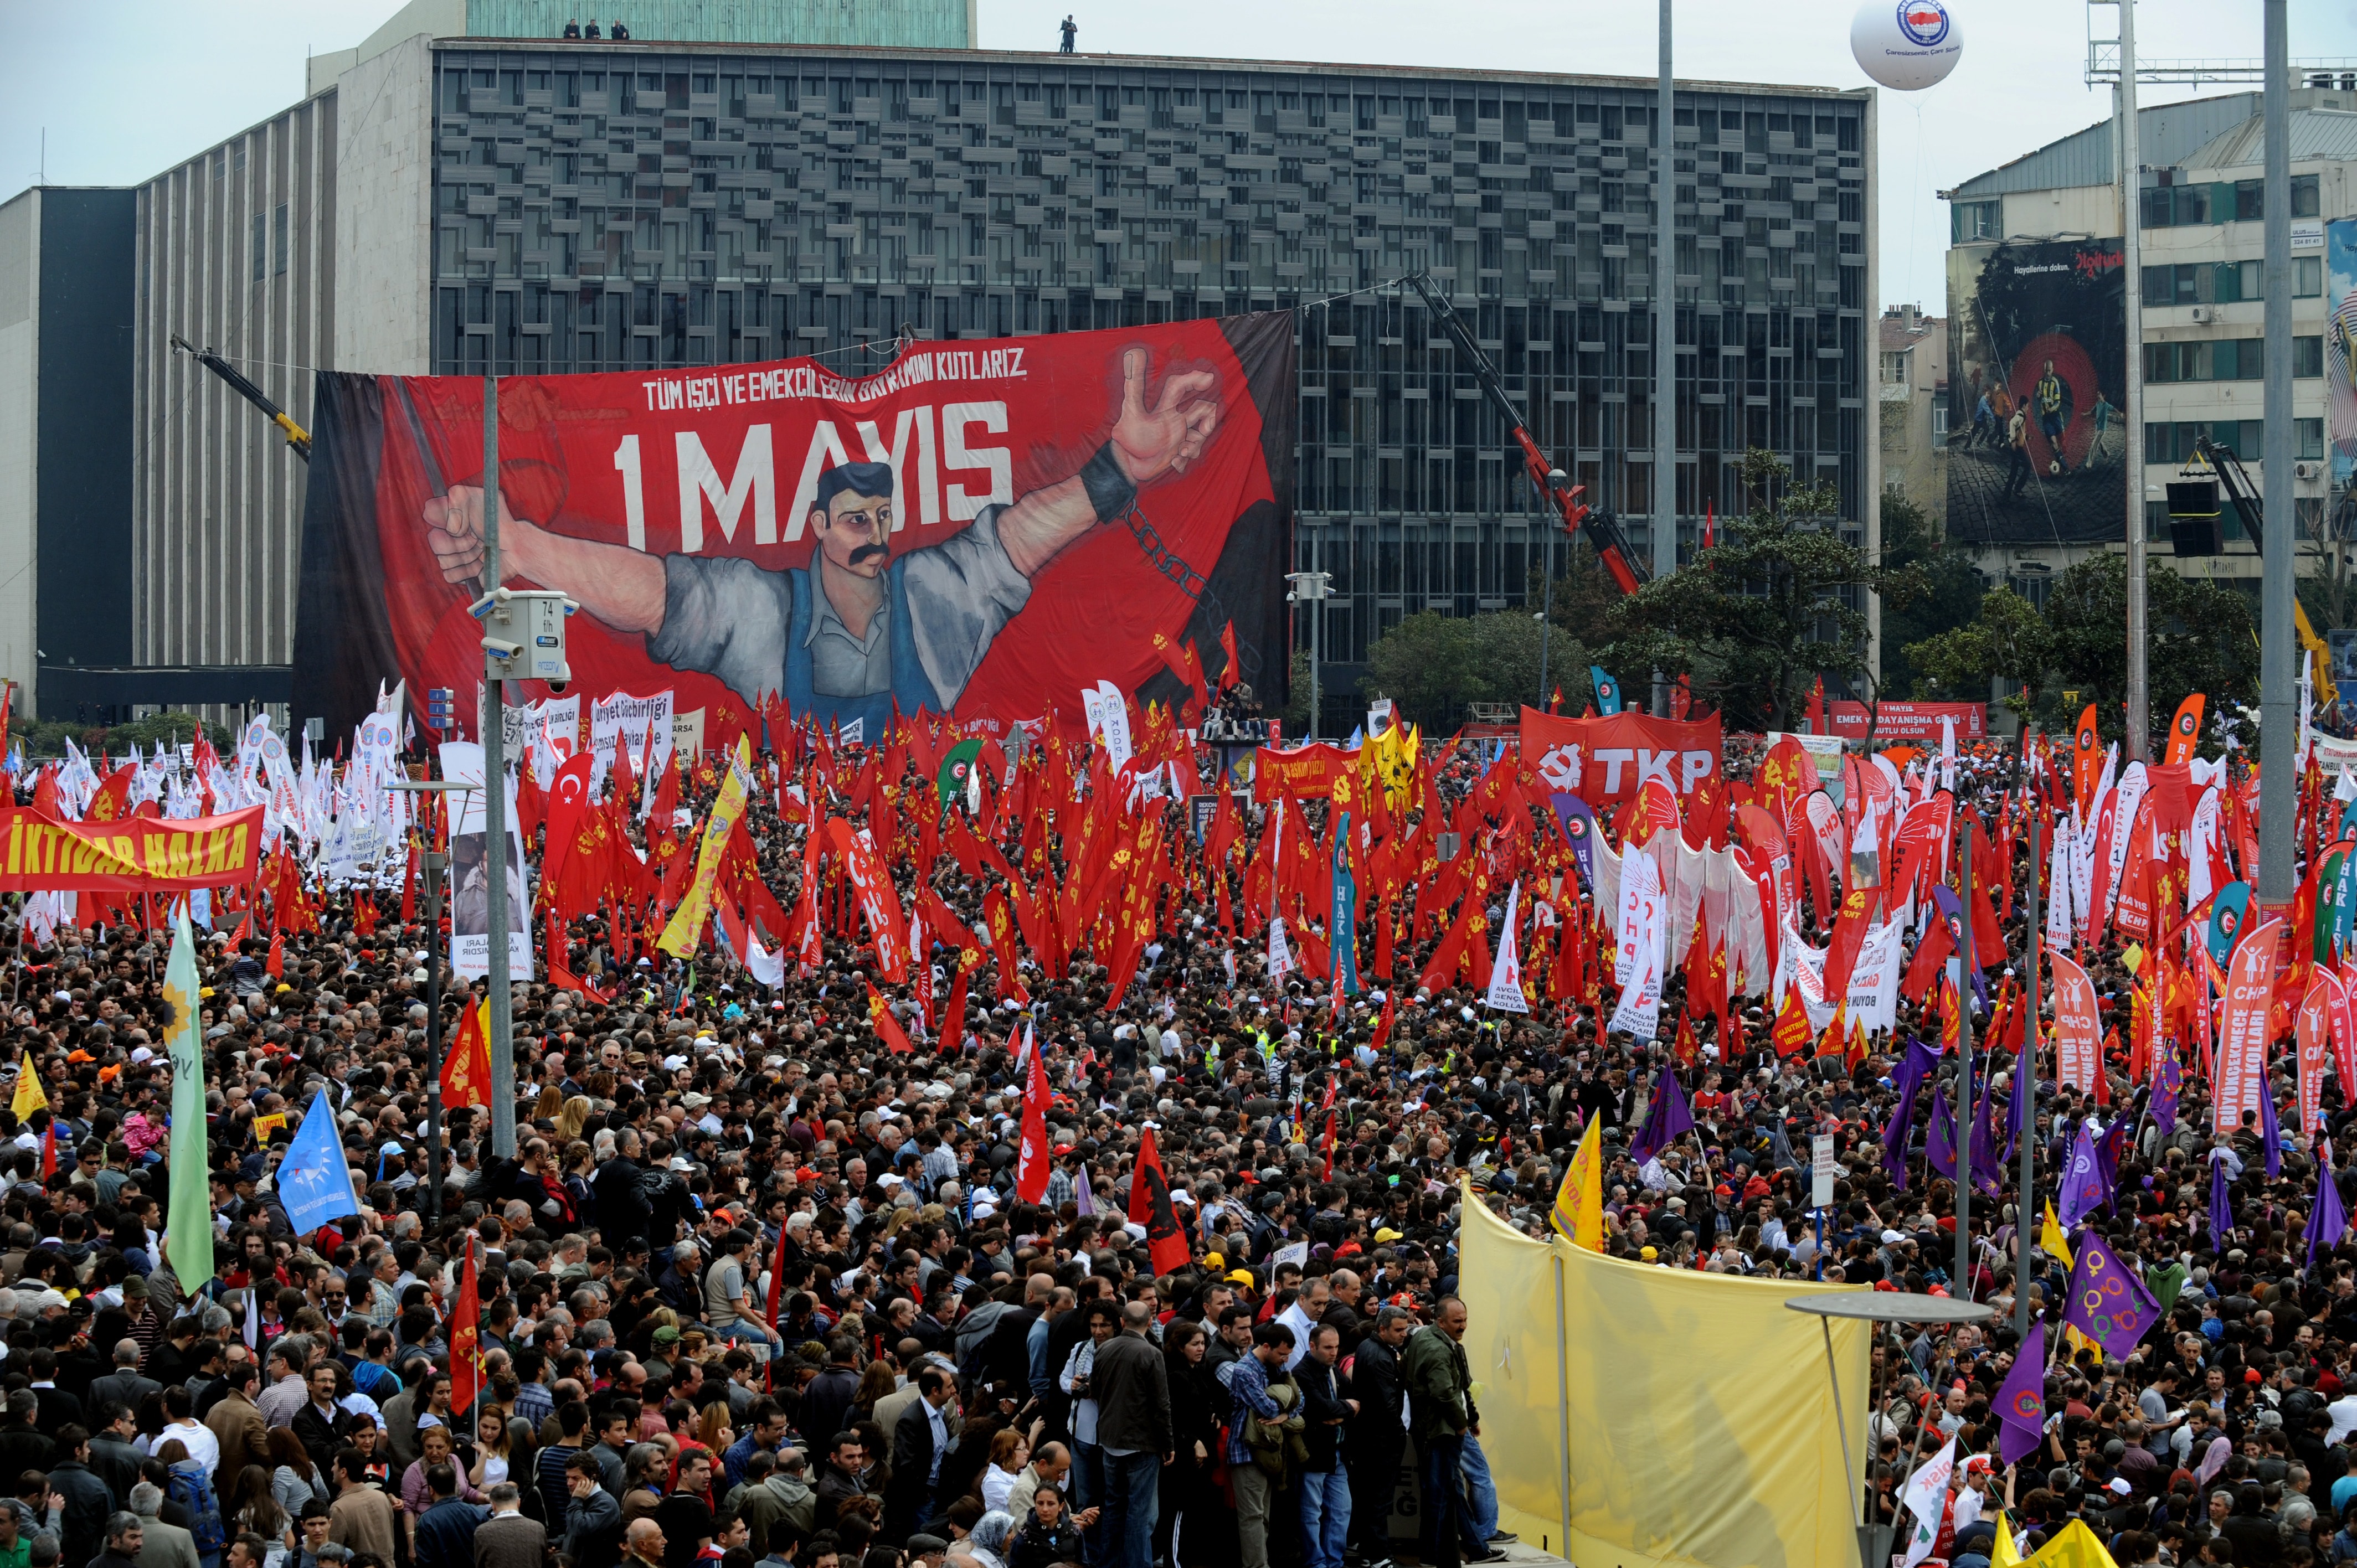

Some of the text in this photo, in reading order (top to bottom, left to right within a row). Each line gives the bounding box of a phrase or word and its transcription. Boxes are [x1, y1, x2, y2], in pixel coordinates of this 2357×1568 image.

[2014, 263, 2070, 276] Hayallerine dokun.
[642, 380, 682, 411] TÜM
[687, 375, 721, 413] İŞÇİ
[723, 375, 745, 405] VE
[749, 364, 857, 404] EMEKÇİLERİN
[936, 347, 1028, 381] KUTLARIZ
[613, 400, 1013, 554] 1 MAYIS
[543, 601, 553, 616] 74
[1836, 715, 1862, 724] EMEK
[1879, 715, 1933, 726] DAYANIŞMA
[1874, 725, 1926, 734] KUTLU OLSUN
[1594, 749, 1713, 793] TKP
[1484, 788, 1495, 798] TKP
[144, 823, 248, 879] HALKA
[577, 845, 591, 855] TKP
[2113, 849, 2121, 862] 1
[2335, 862, 2350, 907] HAK
[1337, 885, 1346, 935] HAK
[2118, 894, 2148, 911] MAYIS
[2055, 911, 2061, 926] 1
[2127, 914, 2148, 927] CHP
[2047, 929, 2070, 941] MAYIS
[1494, 992, 1524, 1002] GENÇL
[1496, 986, 1521, 995] AVCIL
[2234, 986, 2267, 1000] CHP
[1619, 1014, 1655, 1029] GENÇLİK
[1623, 1007, 1656, 1022] AVCILAR
[1615, 1019, 1653, 1035] KOLLARI
[2245, 1010, 2265, 1075] KOLLARI
[2220, 1008, 2249, 1126] BÜYÜKÇEKMECE
[1280, 1245, 1300, 1260] Casper
